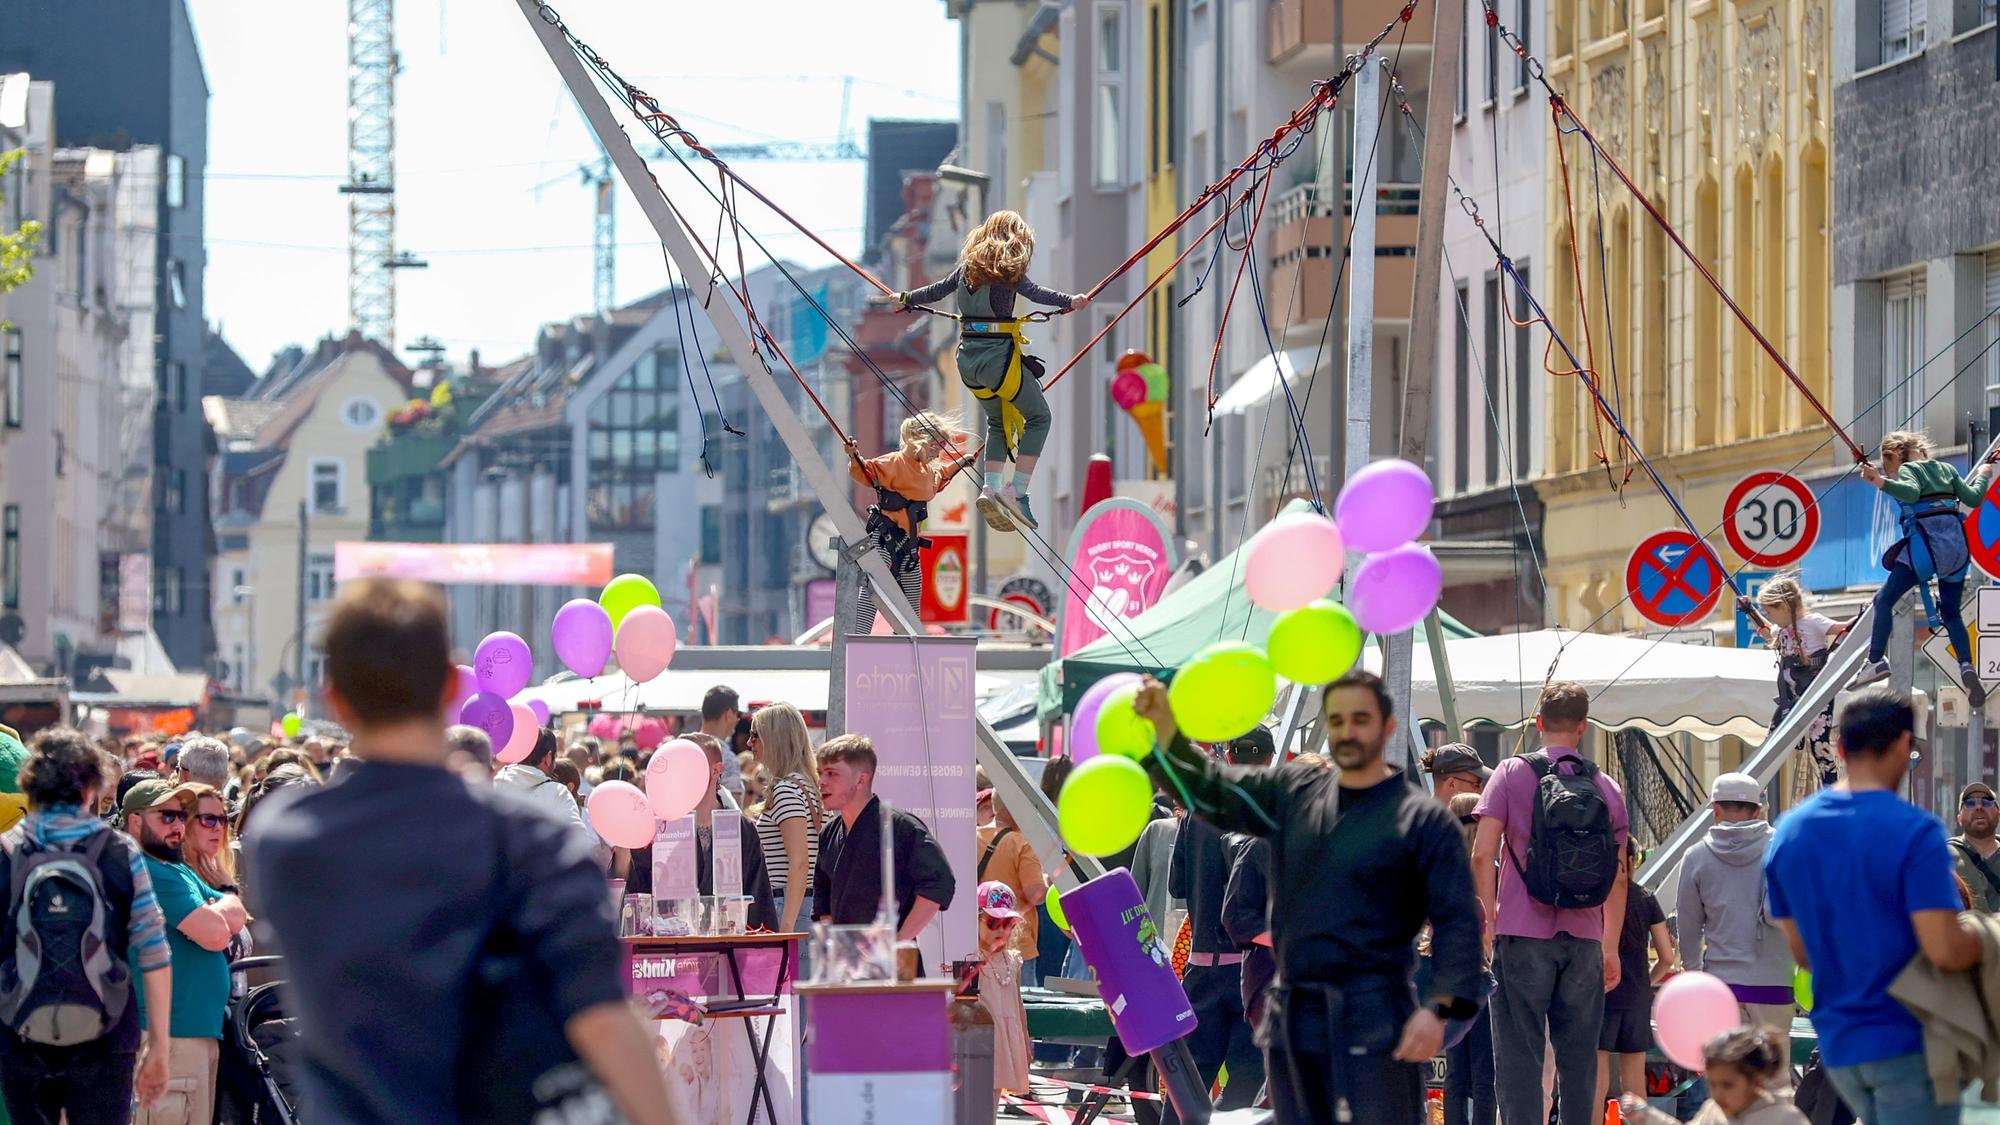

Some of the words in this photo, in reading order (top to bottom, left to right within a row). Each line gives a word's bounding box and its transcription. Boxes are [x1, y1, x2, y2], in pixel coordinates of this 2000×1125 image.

[1743, 498, 1798, 541] 30
[1087, 541, 1112, 556] RUGBY
[1112, 540, 1135, 550] SPORT
[1135, 542, 1159, 560] VEREIN
